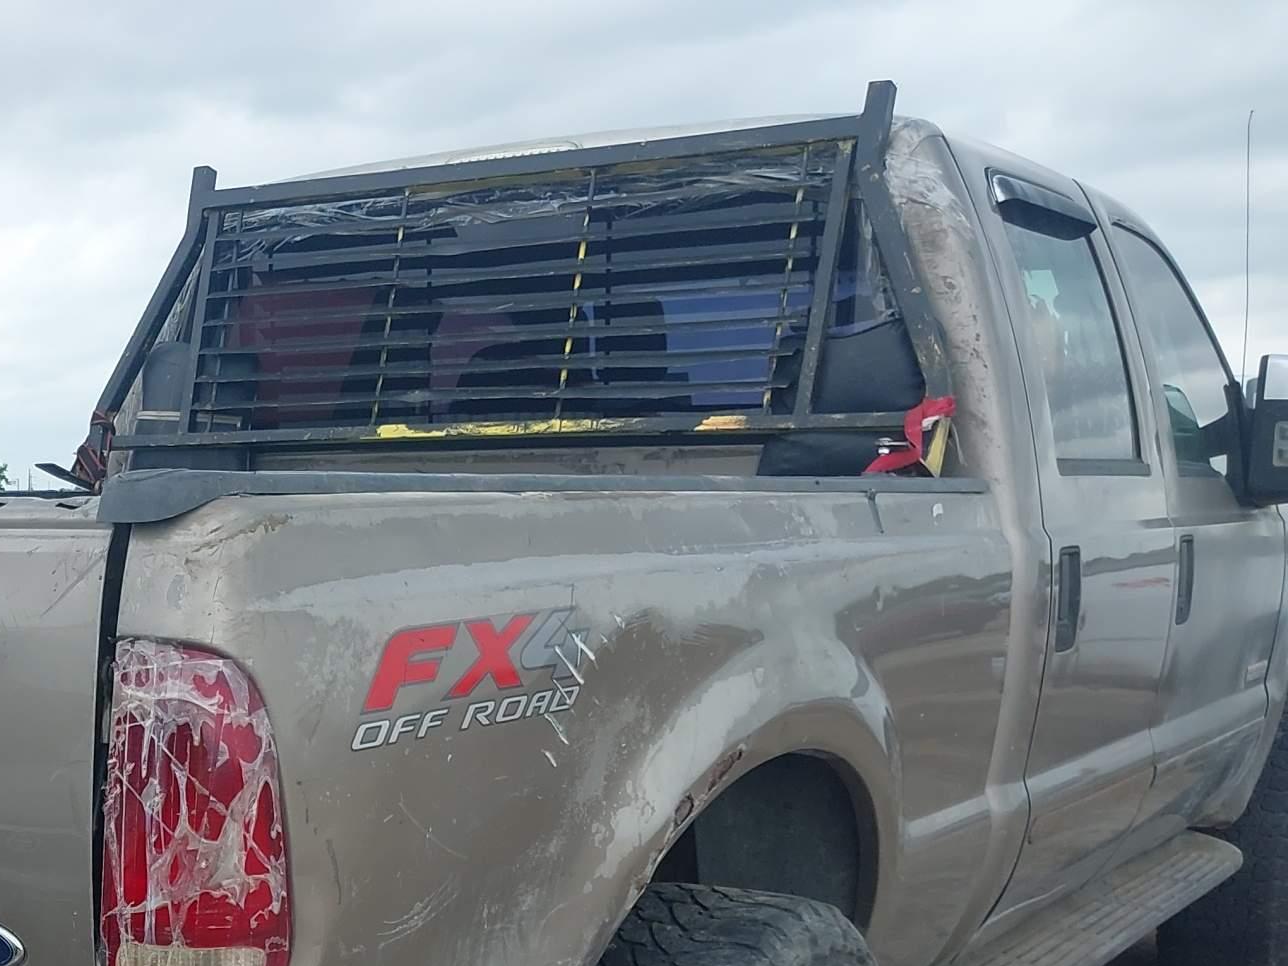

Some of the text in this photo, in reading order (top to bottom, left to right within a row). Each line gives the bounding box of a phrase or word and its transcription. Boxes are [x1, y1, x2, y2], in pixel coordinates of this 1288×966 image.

[361, 606, 590, 714] FX4
[351, 686, 581, 752] OFF ROAD
